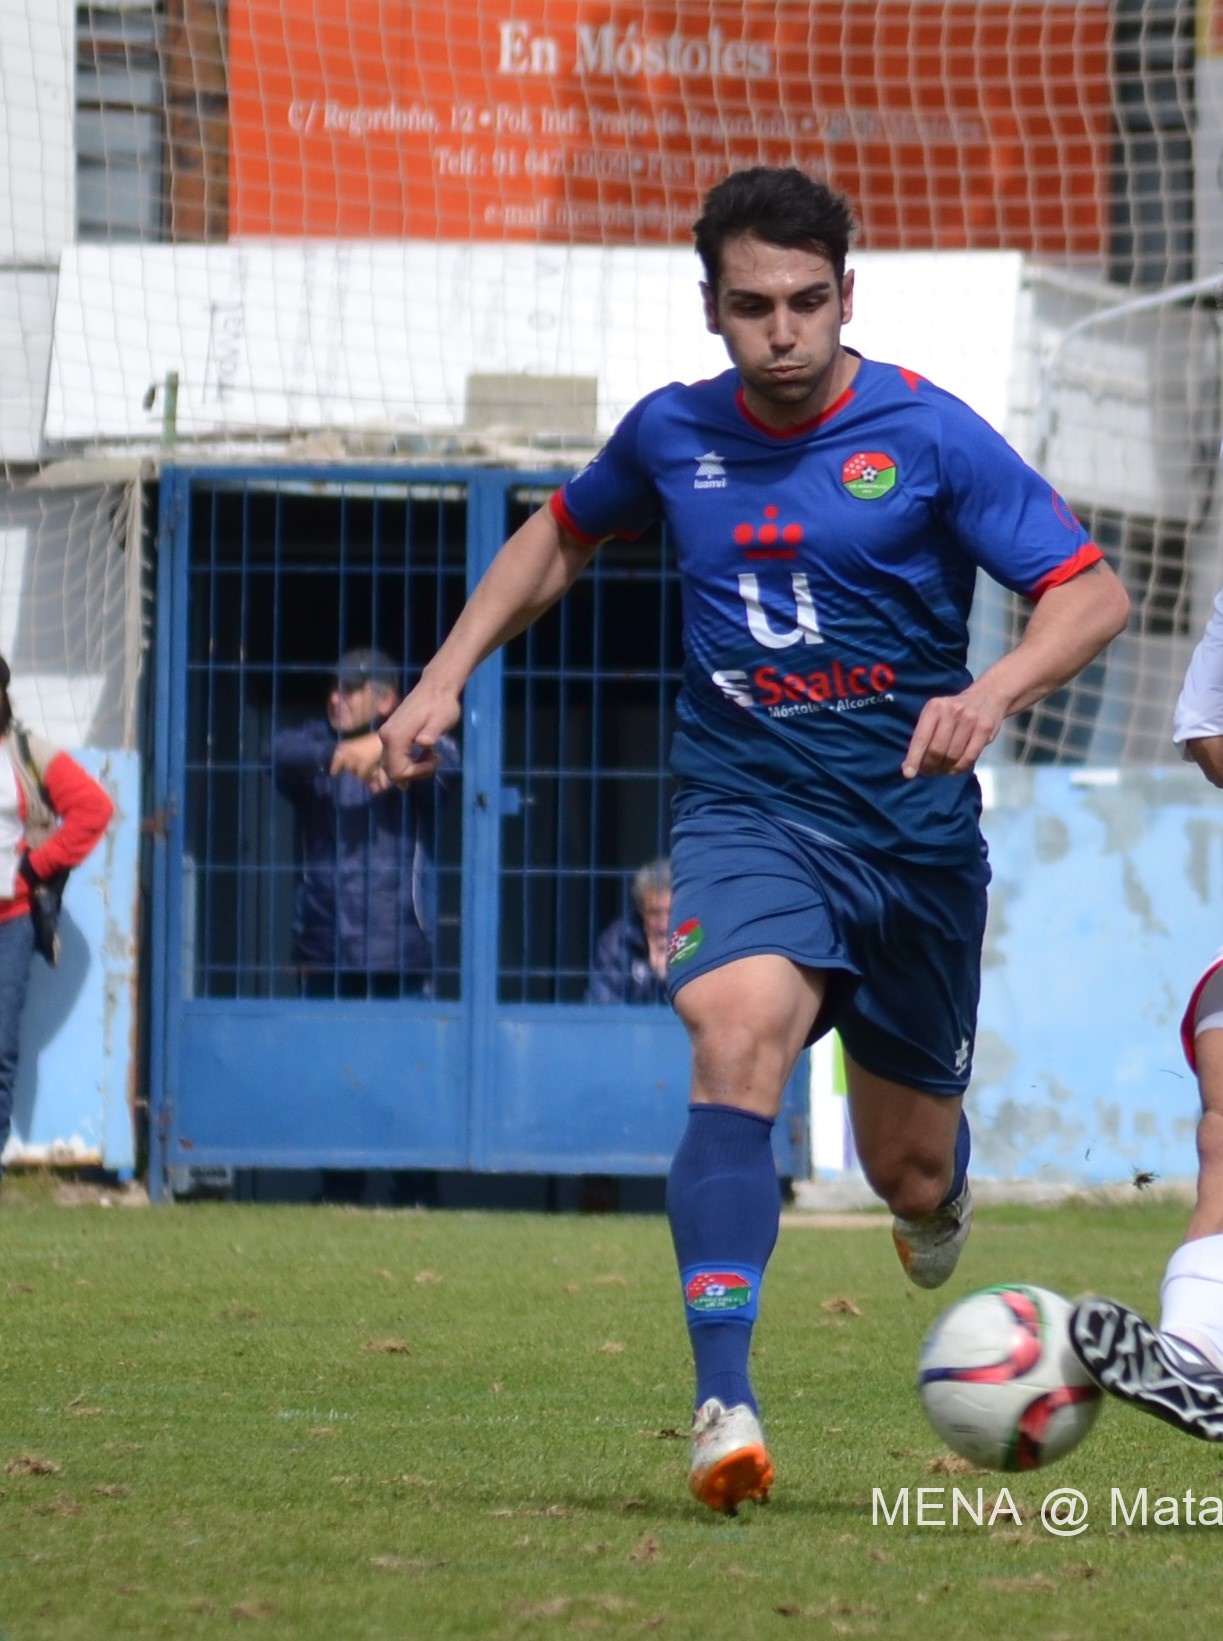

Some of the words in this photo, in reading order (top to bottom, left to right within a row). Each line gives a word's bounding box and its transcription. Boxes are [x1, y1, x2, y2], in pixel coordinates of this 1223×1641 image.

[498, 22, 557, 74] En
[574, 22, 770, 76] Móstoles
[287, 101, 317, 135] C/
[451, 105, 474, 133] 12
[492, 148, 517, 176] 91
[484, 199, 548, 227] e-mail
[768, 702, 826, 719] Móstole
